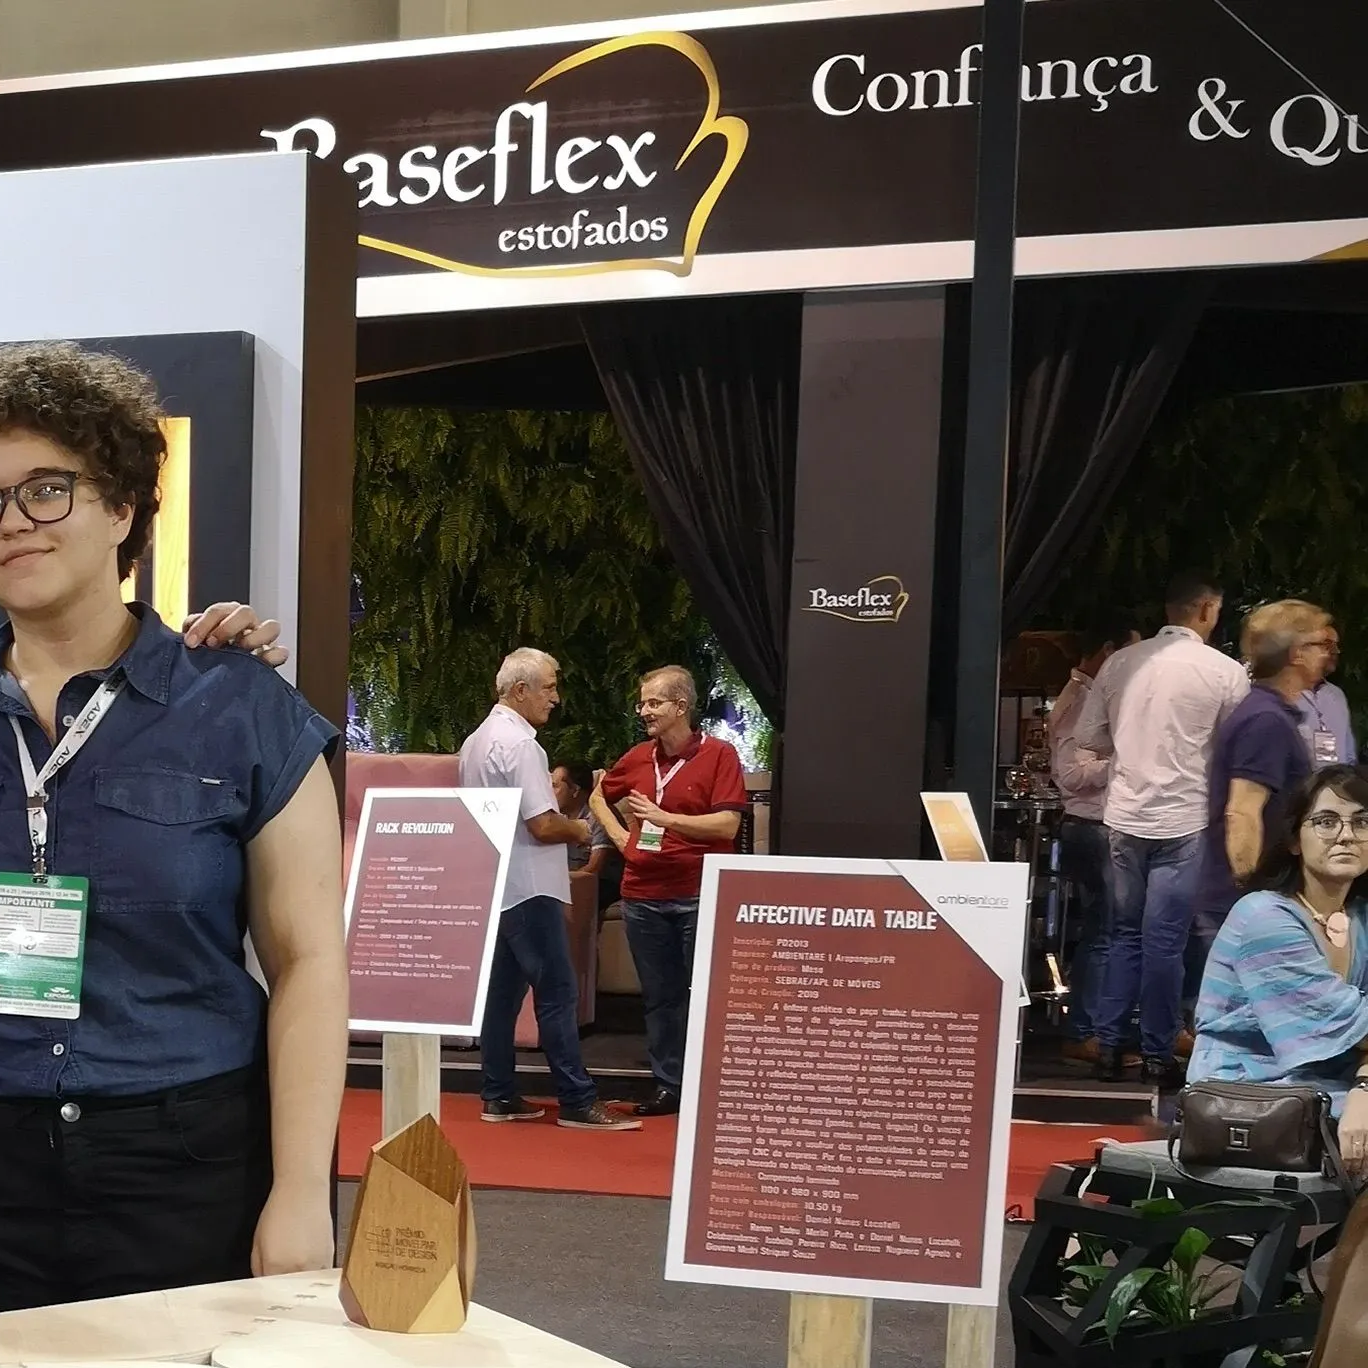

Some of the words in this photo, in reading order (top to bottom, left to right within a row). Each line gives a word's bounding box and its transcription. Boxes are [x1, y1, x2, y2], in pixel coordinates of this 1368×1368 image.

[812, 44, 1158, 112] Confnça
[1188, 77, 1251, 142] &
[498, 206, 669, 253] estofados
[809, 587, 892, 607] Baseflex
[858, 608, 893, 617] estofados
[75, 702, 101, 736] ADEX
[375, 822, 400, 834] RACK
[401, 822, 455, 834] REVOLUTION
[937, 894, 1009, 906] ambientare
[736, 904, 826, 925] AFFECTIVE
[830, 907, 876, 927] DATA
[883, 909, 939, 930] TABLE
[776, 939, 808, 948] PD2013
[771, 951, 825, 961] AMBIENTARE
[774, 976, 829, 986] SEBRAE/APL
[832, 978, 845, 987] DE
[846, 979, 881, 988] MÓVEIS
[797, 989, 819, 998] 2019
[752, 1147, 769, 1156] CNC
[805, 1214, 833, 1225] Daniel
